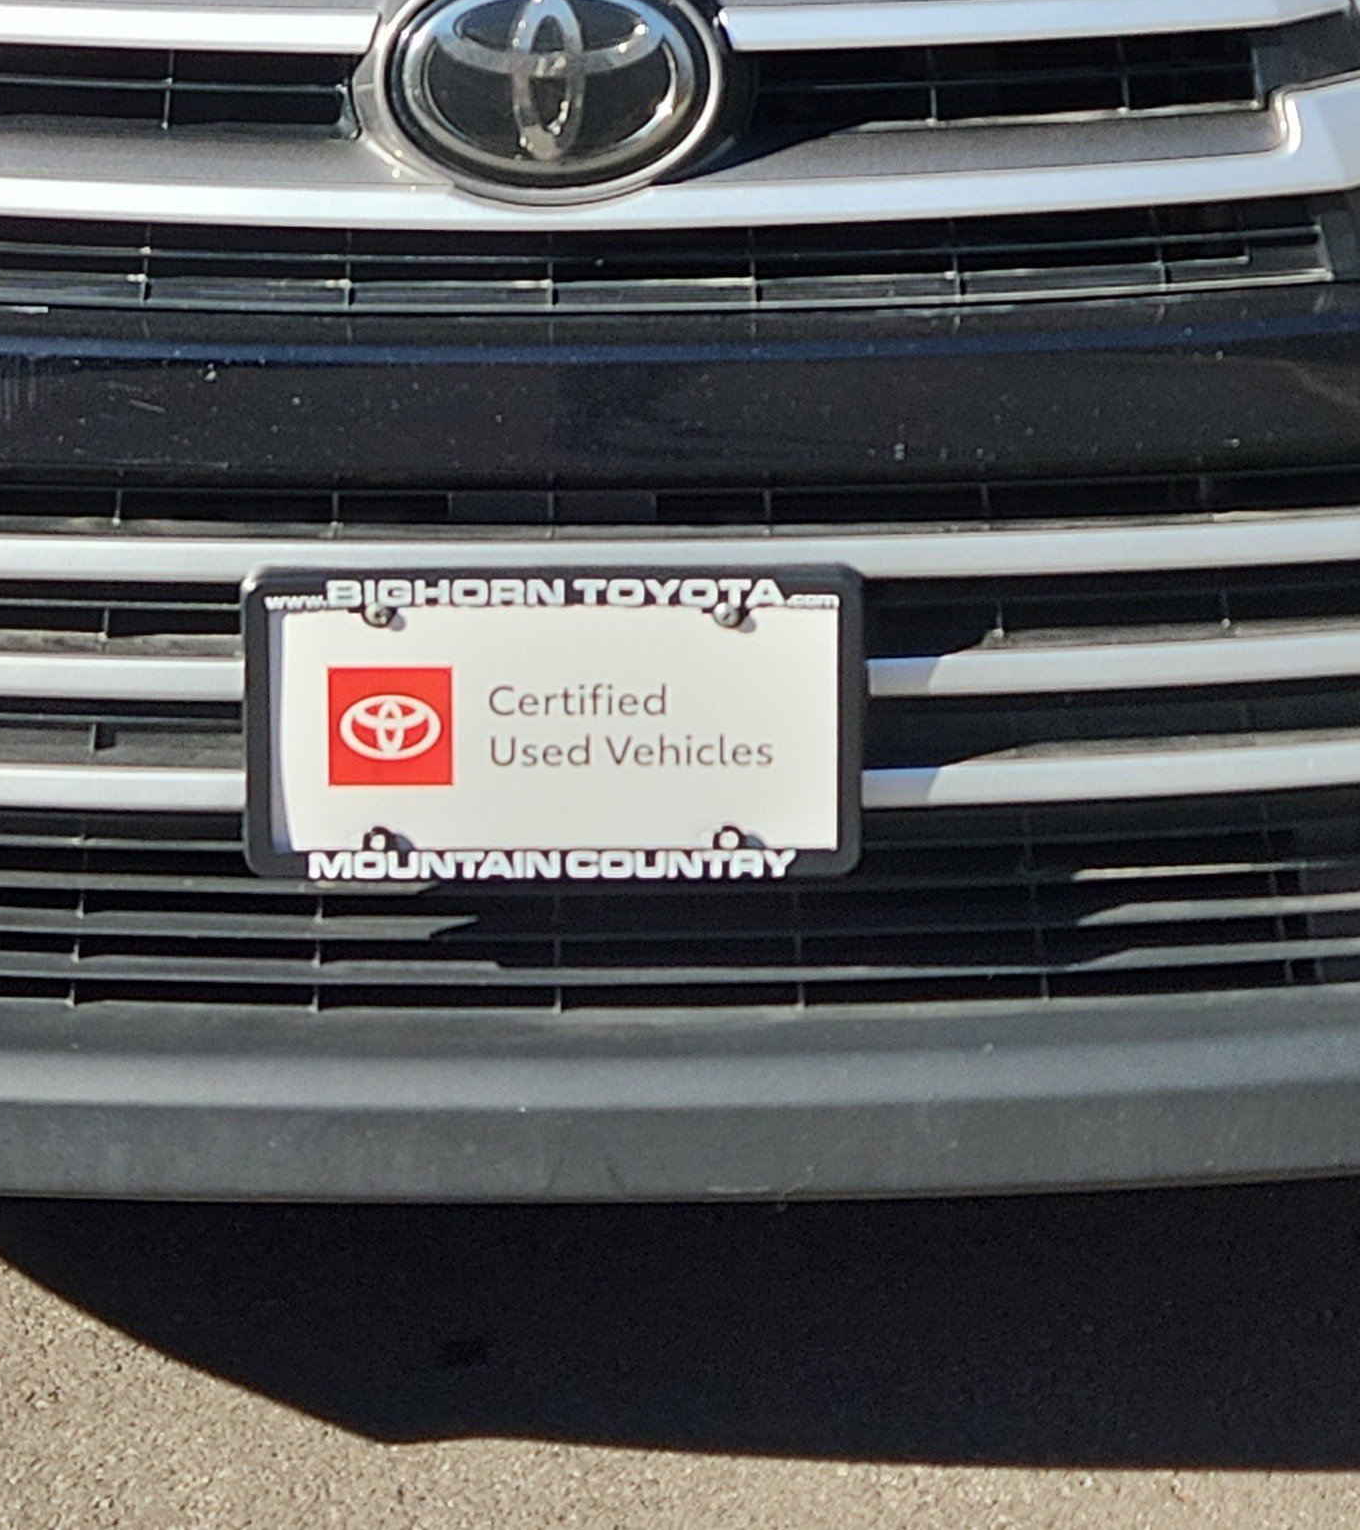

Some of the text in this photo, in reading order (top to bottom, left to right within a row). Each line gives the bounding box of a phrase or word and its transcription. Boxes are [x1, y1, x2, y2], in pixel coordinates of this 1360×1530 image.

[488, 682, 668, 717] Certified
[489, 733, 775, 768] Used Vehicles
[307, 848, 797, 882] MOUNTAIN COUNTRY
